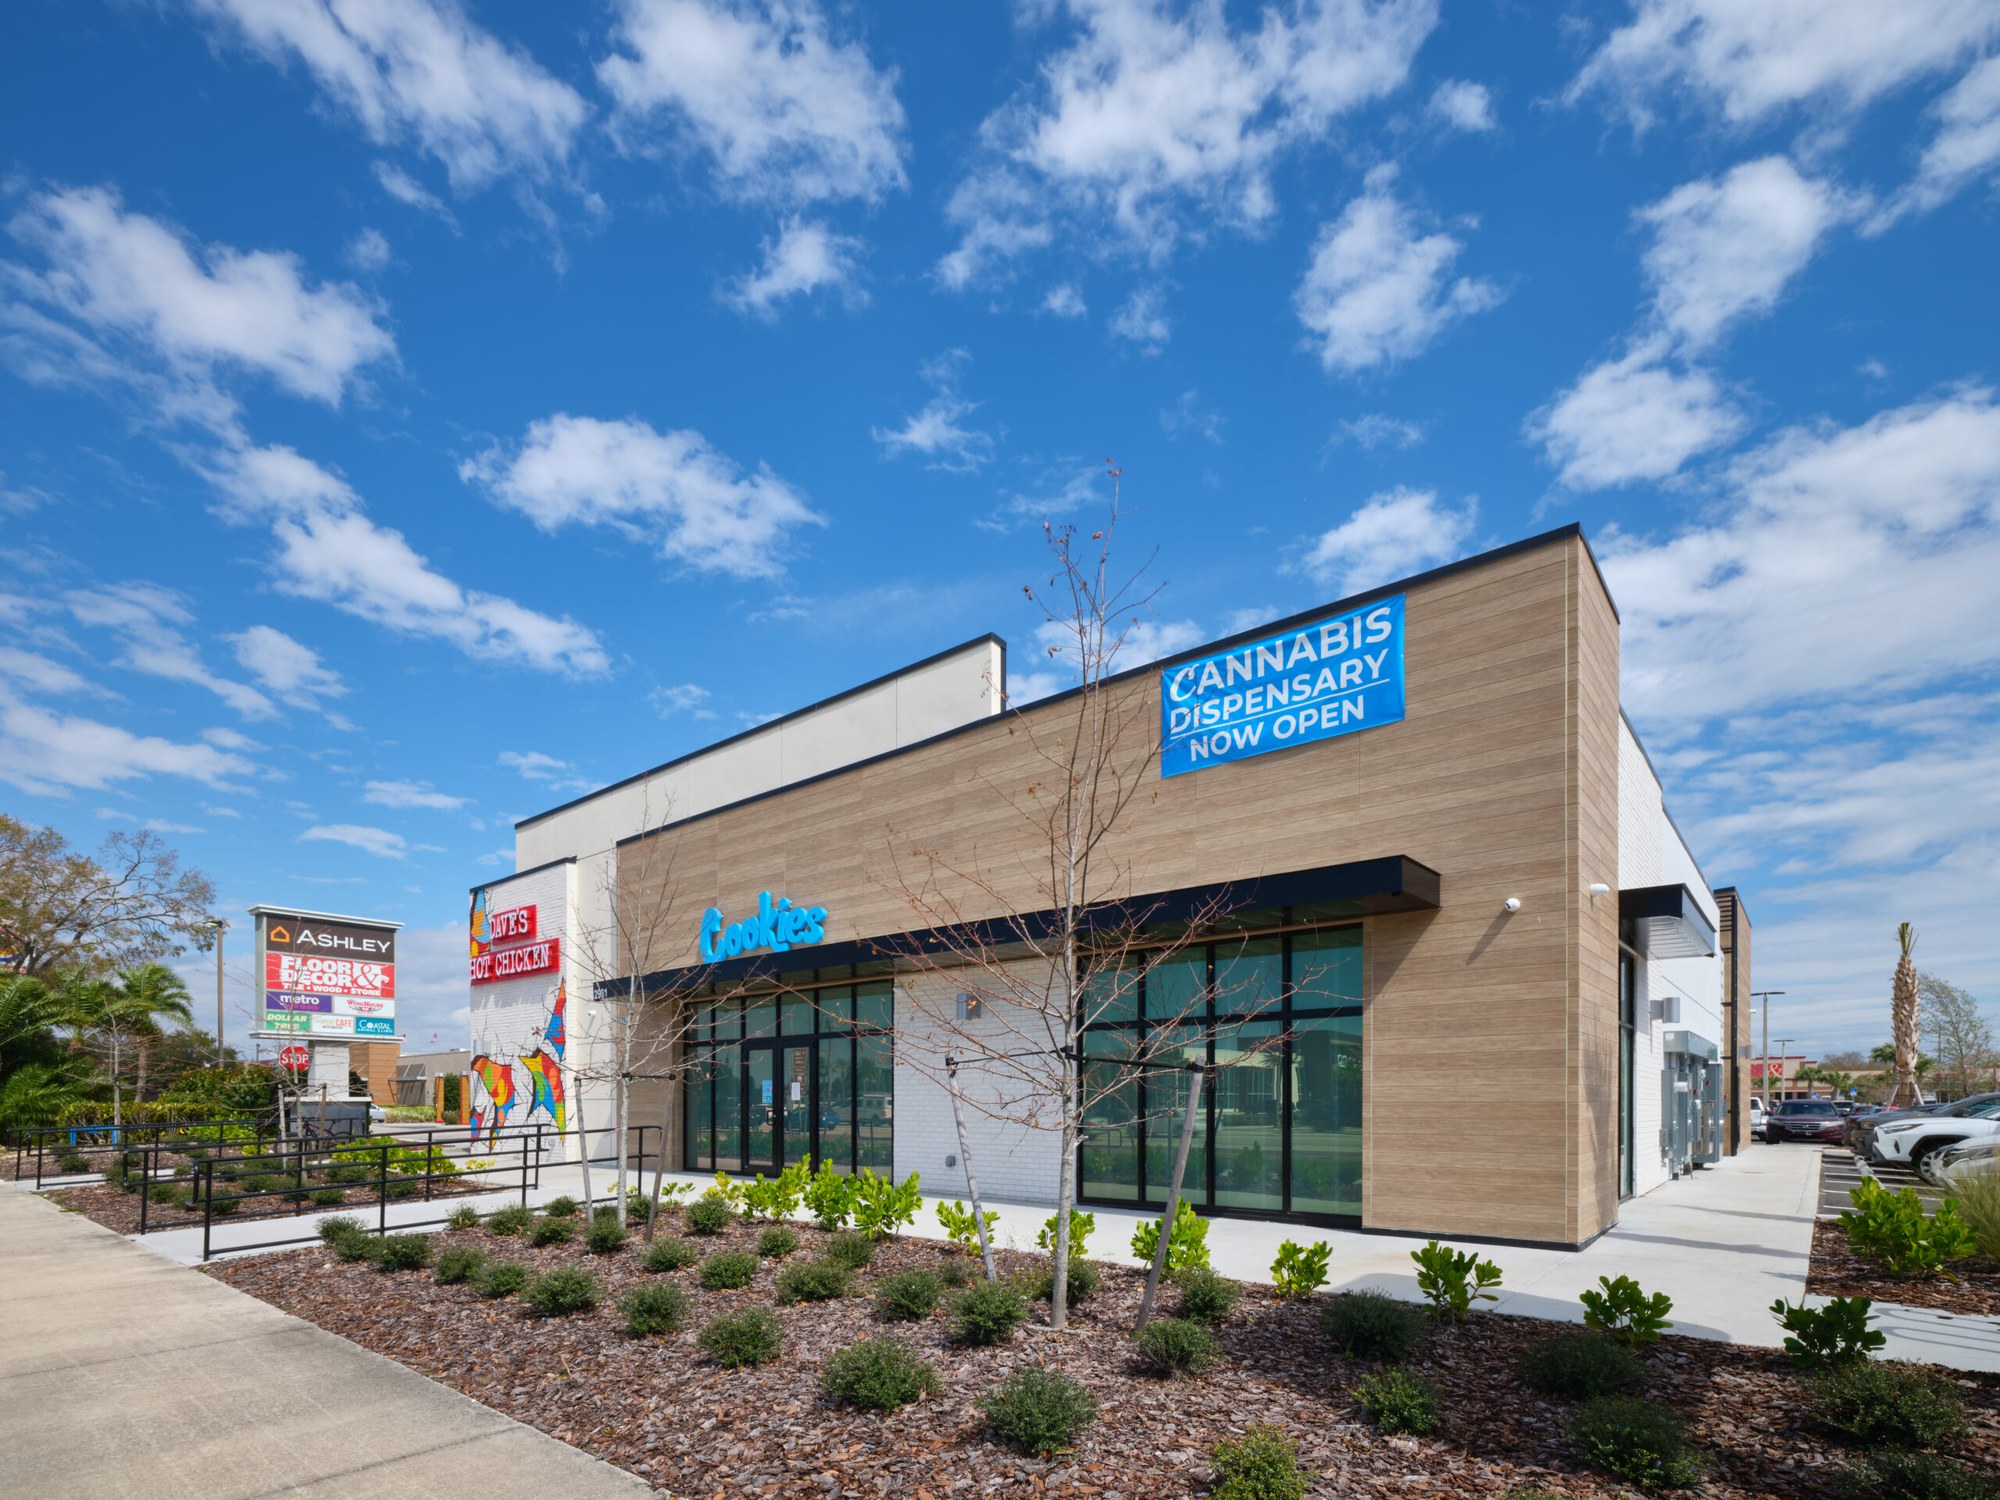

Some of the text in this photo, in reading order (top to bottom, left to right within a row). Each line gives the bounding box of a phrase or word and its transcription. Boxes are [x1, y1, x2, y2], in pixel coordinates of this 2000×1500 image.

[1169, 606, 1393, 702] CANNABIS
[1169, 648, 1389, 735] DISPENSARY
[1190, 694, 1365, 762] NOW OPEN
[487, 907, 529, 940] DAVE'S
[700, 890, 828, 964] Cookies
[296, 929, 391, 953] ASHLEY
[280, 955, 352, 976] FLOOR
[470, 943, 550, 980] HOT CHICKEN
[280, 968, 352, 987] DECOR
[280, 994, 320, 1005] metro
[313, 985, 343, 993] WOOD
[350, 988, 381, 997] STONE
[267, 1013, 307, 1022] DOLLAR
[335, 1019, 353, 1028] CAFE
[281, 1053, 309, 1065] STOP
